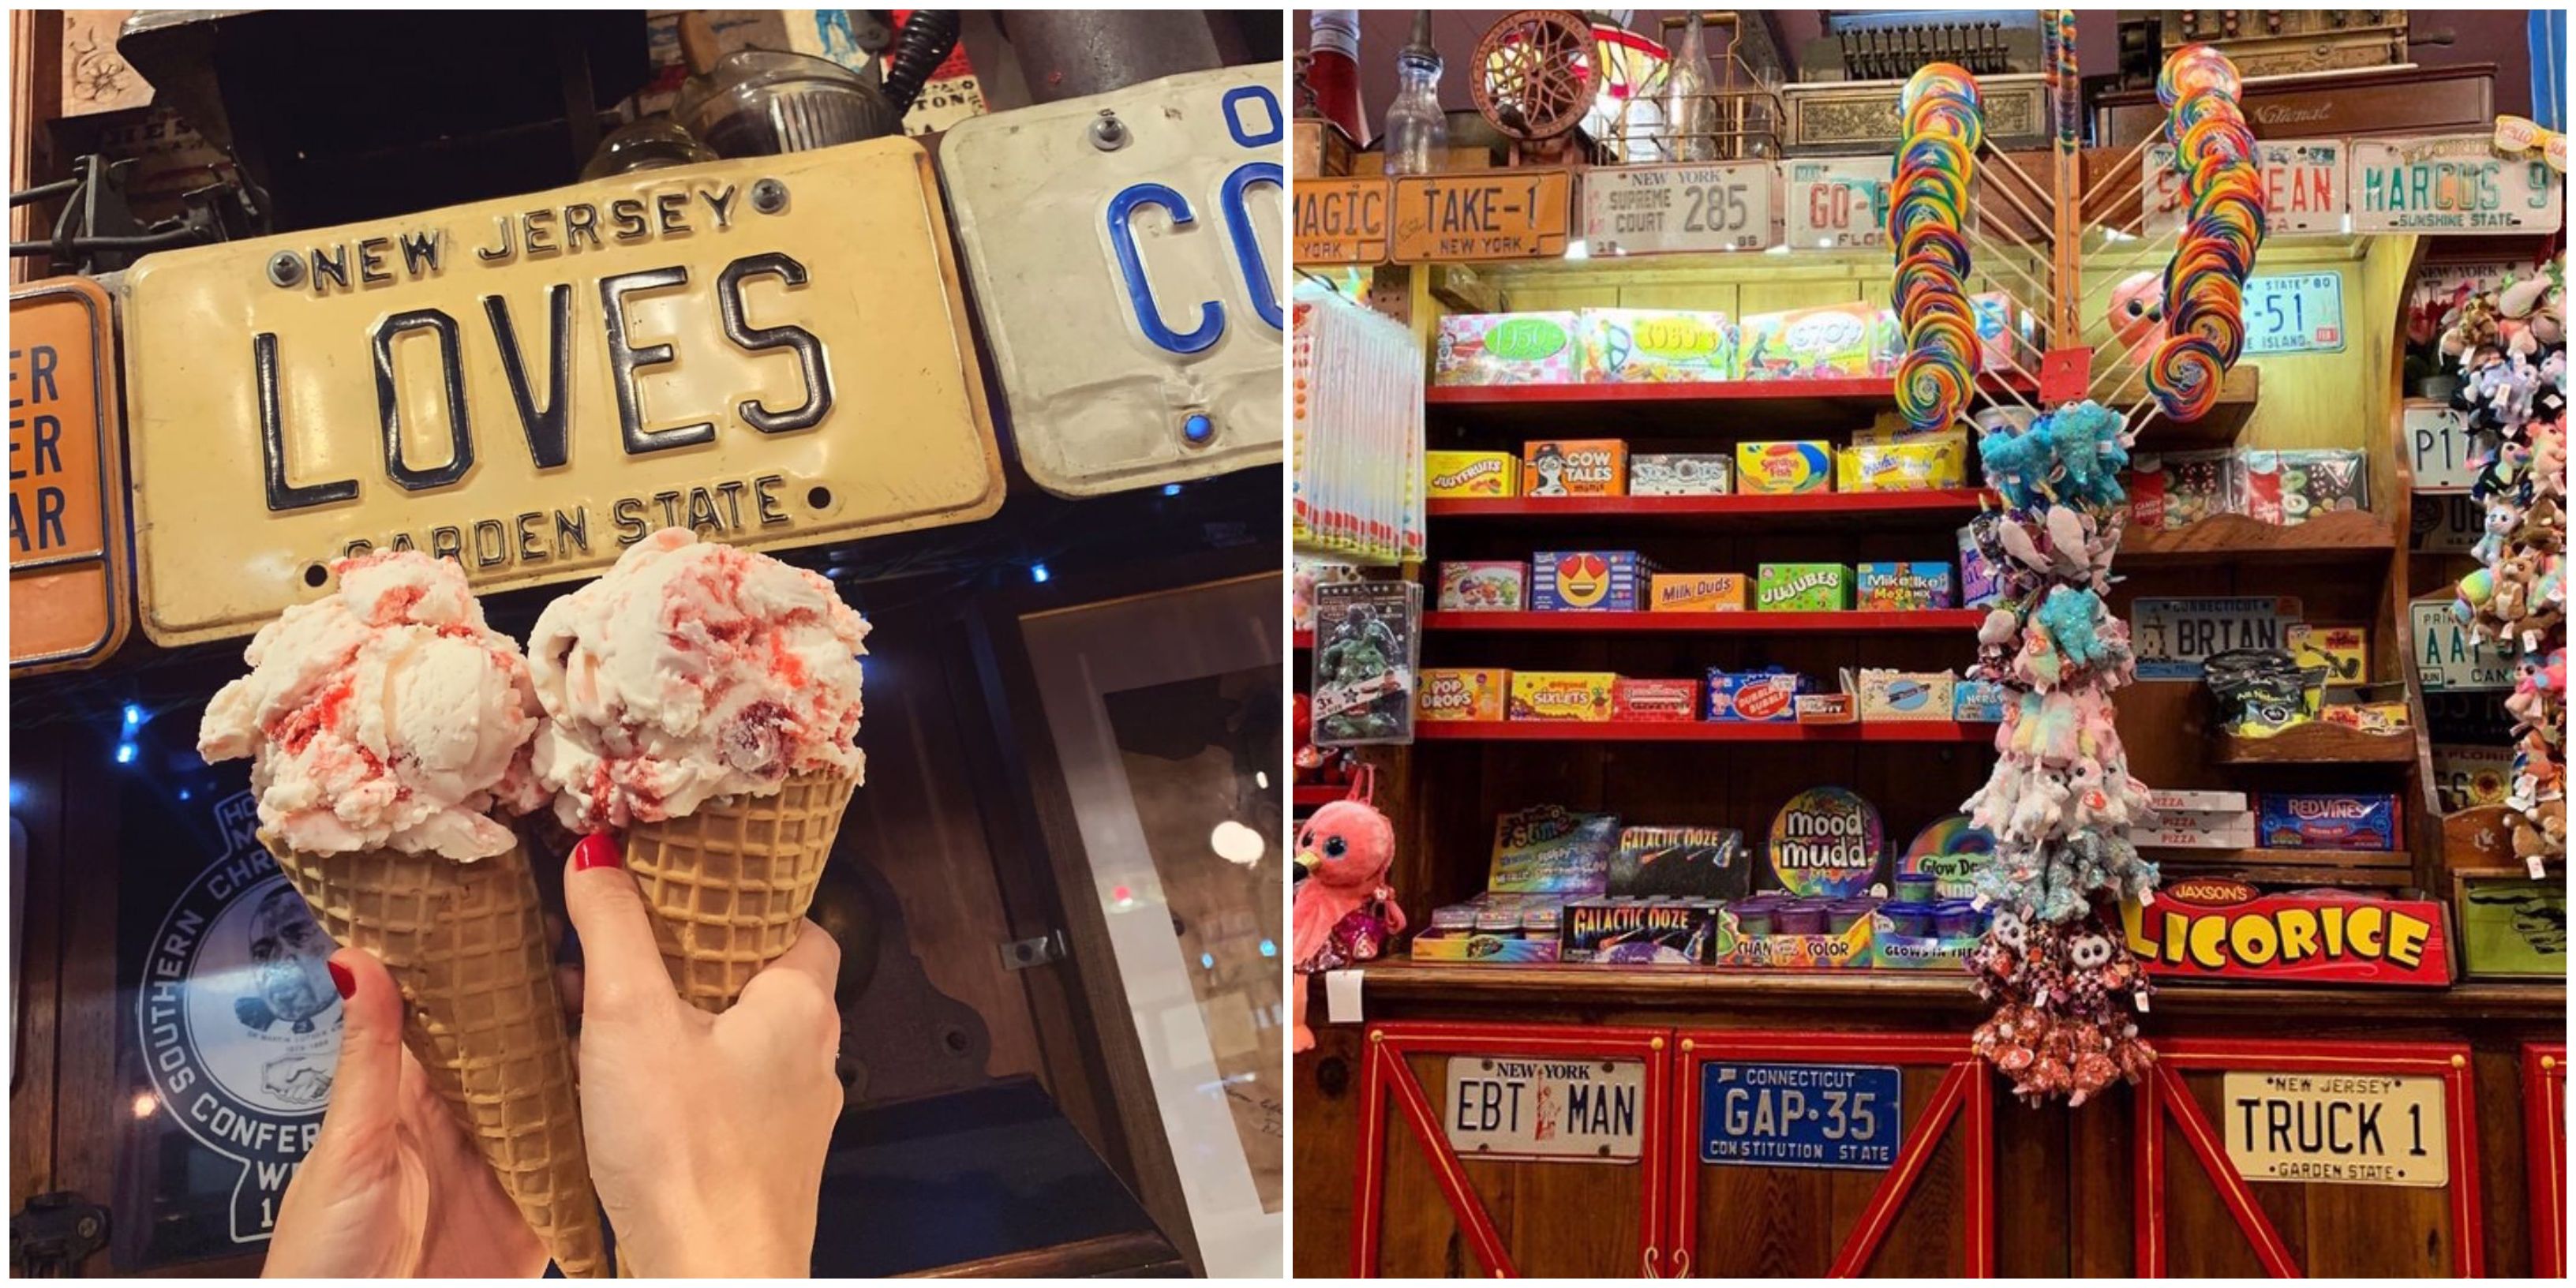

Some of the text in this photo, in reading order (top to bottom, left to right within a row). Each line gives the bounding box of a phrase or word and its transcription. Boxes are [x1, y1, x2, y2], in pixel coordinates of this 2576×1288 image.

[1632, 169, 1721, 186] NEW YORK
[2365, 163, 2548, 212] MARCUS 9
[1608, 189, 1672, 210] SUPREME
[1684, 185, 1747, 233] 285
[1424, 186, 1538, 234] TAKE-1
[2399, 212, 2513, 227] SUNSHINE STATE
[1616, 212, 1666, 234] COURT
[313, 184, 737, 290] NEW JERSEY
[1440, 238, 1522, 253] NEW YORK
[1302, 243, 1342, 257] YORK
[2458, 264, 2498, 277] YORK
[2266, 279, 2301, 290] STATE
[2262, 335, 2306, 349] ISLAND
[254, 253, 833, 511] LOVES
[1567, 451, 1612, 466] COW
[1566, 466, 1612, 482] TALES
[344, 475, 788, 567] GARDEN STATE
[1663, 576, 1732, 603] Milk Duds
[1761, 571, 1840, 605] JUJUBES
[2177, 618, 2277, 656] BRIAN
[1431, 680, 1462, 695] POP
[1421, 691, 1473, 709] DROPS
[2289, 799, 2365, 818] RED VINES
[1787, 805, 1863, 836] mood
[2162, 816, 2197, 828] PIZZA
[1621, 827, 1720, 852] GALACTIC OOZE
[2162, 833, 2196, 845] PIZZA
[1781, 839, 1867, 868] mudd
[1919, 857, 1957, 876] Glow
[2175, 886, 2248, 902] JAXSON'S
[1574, 908, 1689, 936] GALACTIC OOZE
[2121, 897, 2431, 969] LICORICE
[1807, 942, 1849, 957] COLOR
[151, 908, 205, 1094] SOUTHERN
[1496, 1062, 1590, 1080] NEW YORK
[1746, 1069, 1856, 1088] CONNECTICUT
[2275, 1077, 2392, 1095] NEW JERSEY
[1457, 1080, 1635, 1136] EBT MAN
[2237, 1097, 2428, 1156] TRUCK 1
[1709, 1139, 1889, 1162] CONSTITUTION STATE
[2278, 1163, 2394, 1181] GARDEN STATE
